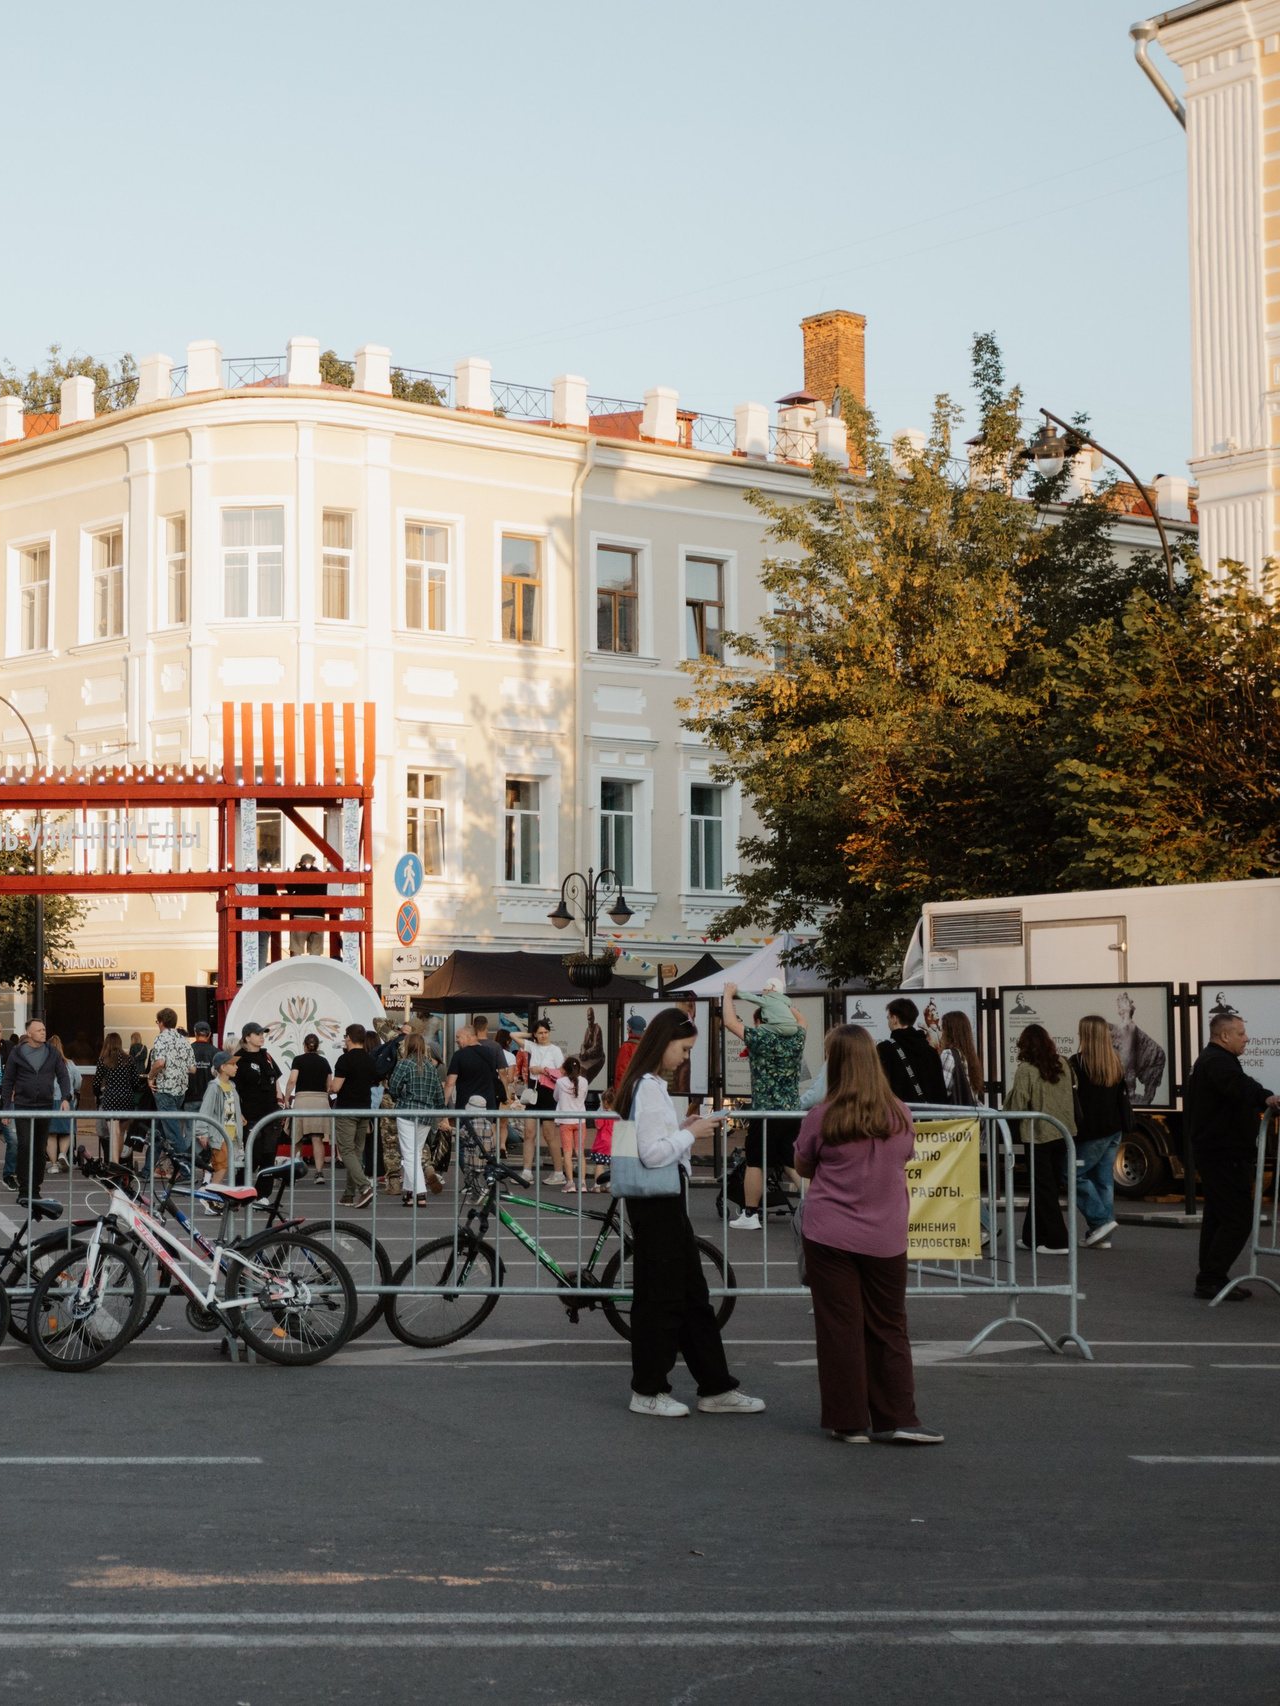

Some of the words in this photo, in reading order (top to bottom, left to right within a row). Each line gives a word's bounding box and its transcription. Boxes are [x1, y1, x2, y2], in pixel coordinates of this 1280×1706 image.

[27, 817, 138, 851] УЛИЧНОЙ
[148, 821, 202, 852] ЕДЫ
[61, 956, 118, 970] DIAMONDS
[1240, 1058, 1264, 1067] ЕНСКЕ
[914, 1128, 972, 1144] ОТОВКОЙ
[911, 1186, 964, 1199] РАБОТЫ.
[908, 1222, 957, 1233] ВИНЕНИЯ
[136, 1223, 165, 1251] STERN
